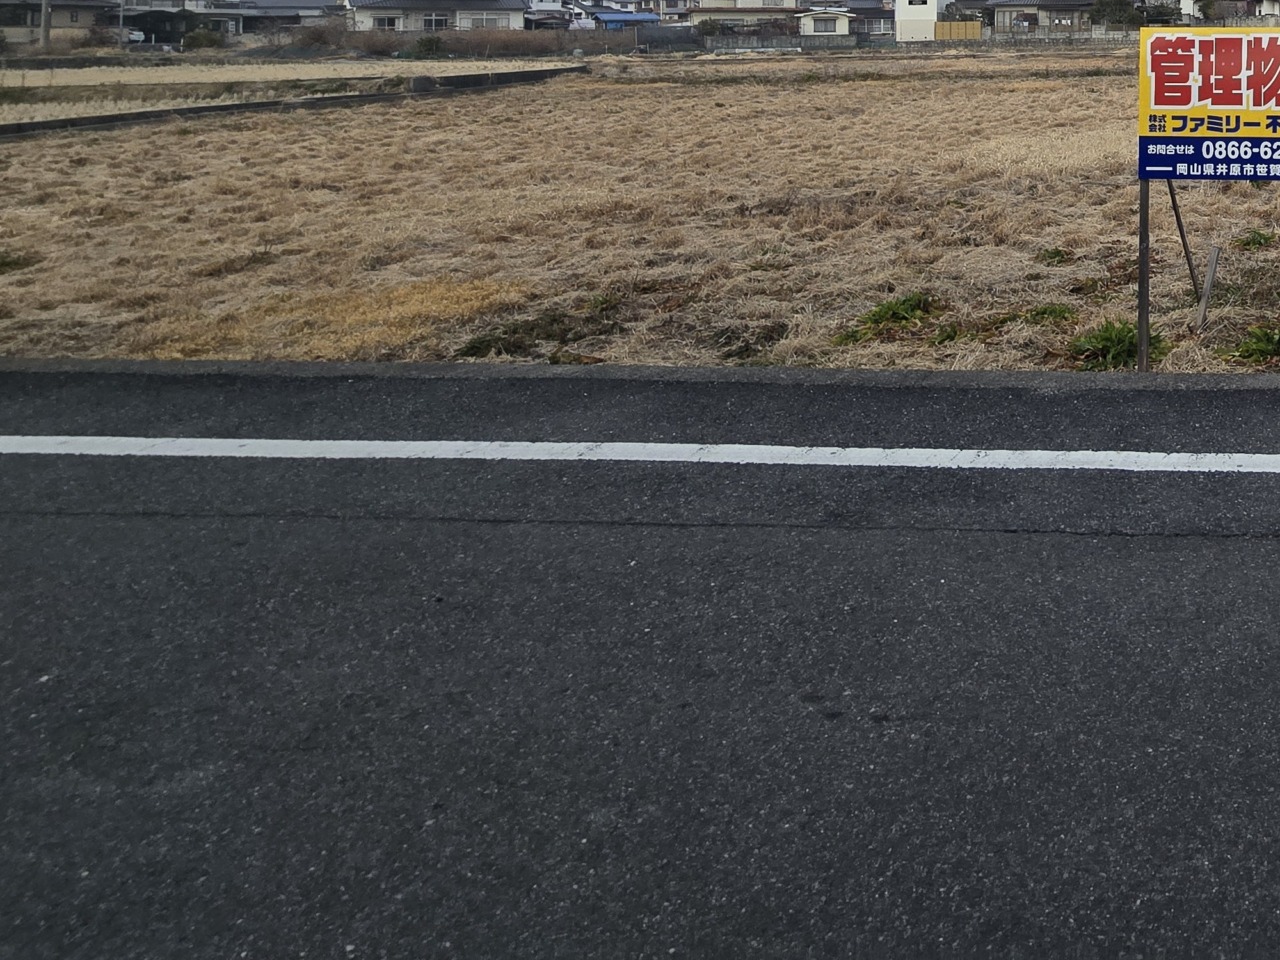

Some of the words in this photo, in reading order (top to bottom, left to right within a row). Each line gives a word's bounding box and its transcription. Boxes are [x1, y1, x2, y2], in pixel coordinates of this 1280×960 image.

[1147, 144, 1195, 155] お問合せは
